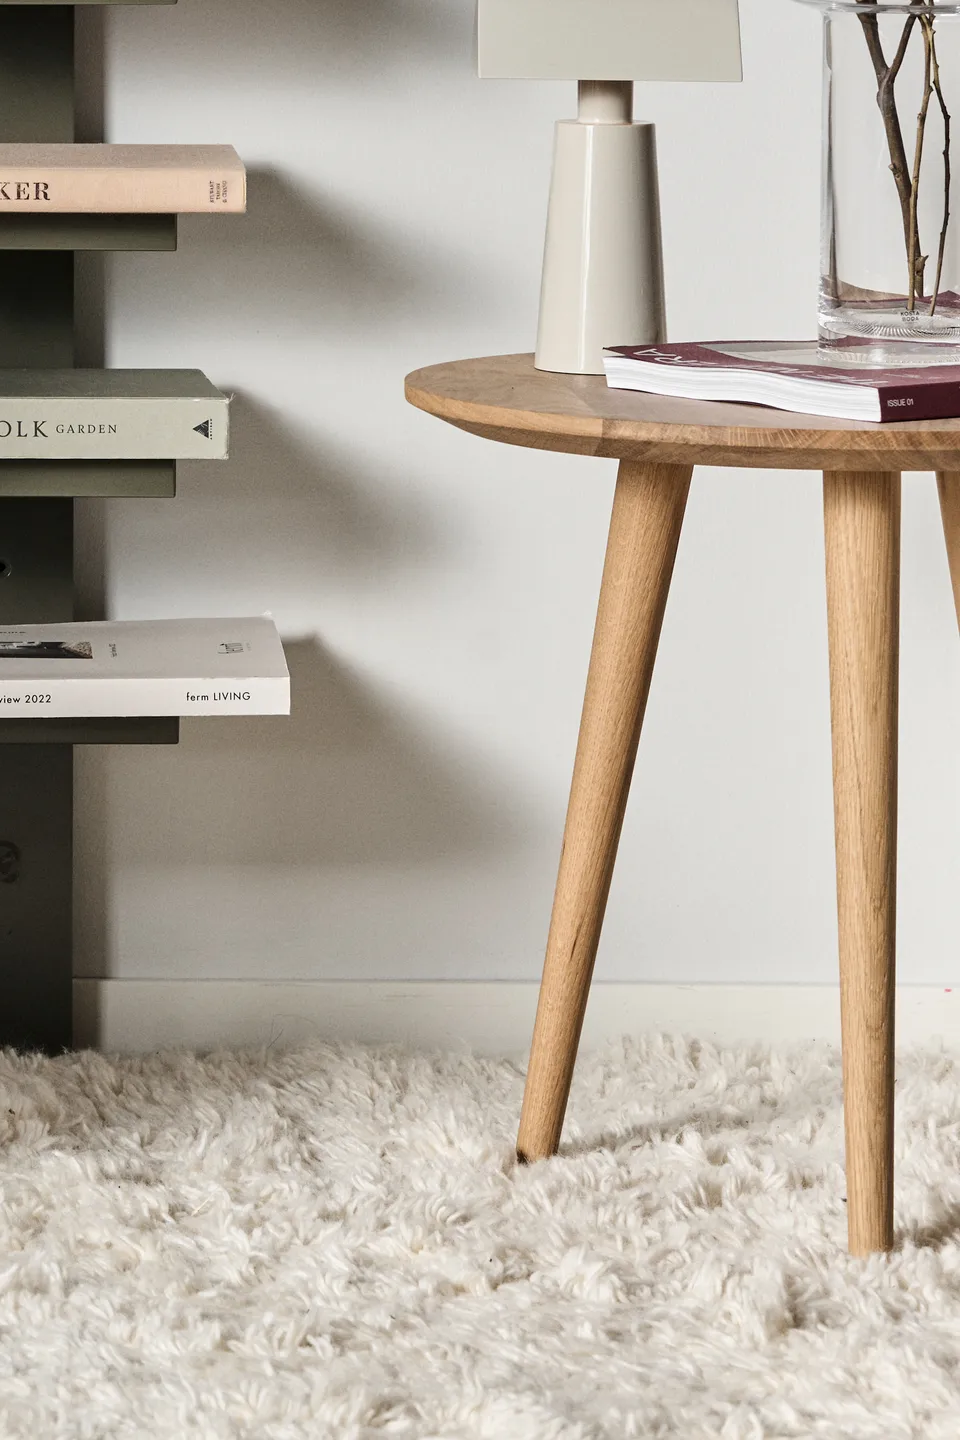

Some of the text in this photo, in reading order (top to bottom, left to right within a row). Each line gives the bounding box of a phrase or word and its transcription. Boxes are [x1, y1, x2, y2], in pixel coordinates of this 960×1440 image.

[887, 398, 914, 407] ISSUE 01
[55, 424, 117, 434] GARDEN
[24, 694, 52, 704] 2022
[186, 691, 251, 702] ferm LIVING
